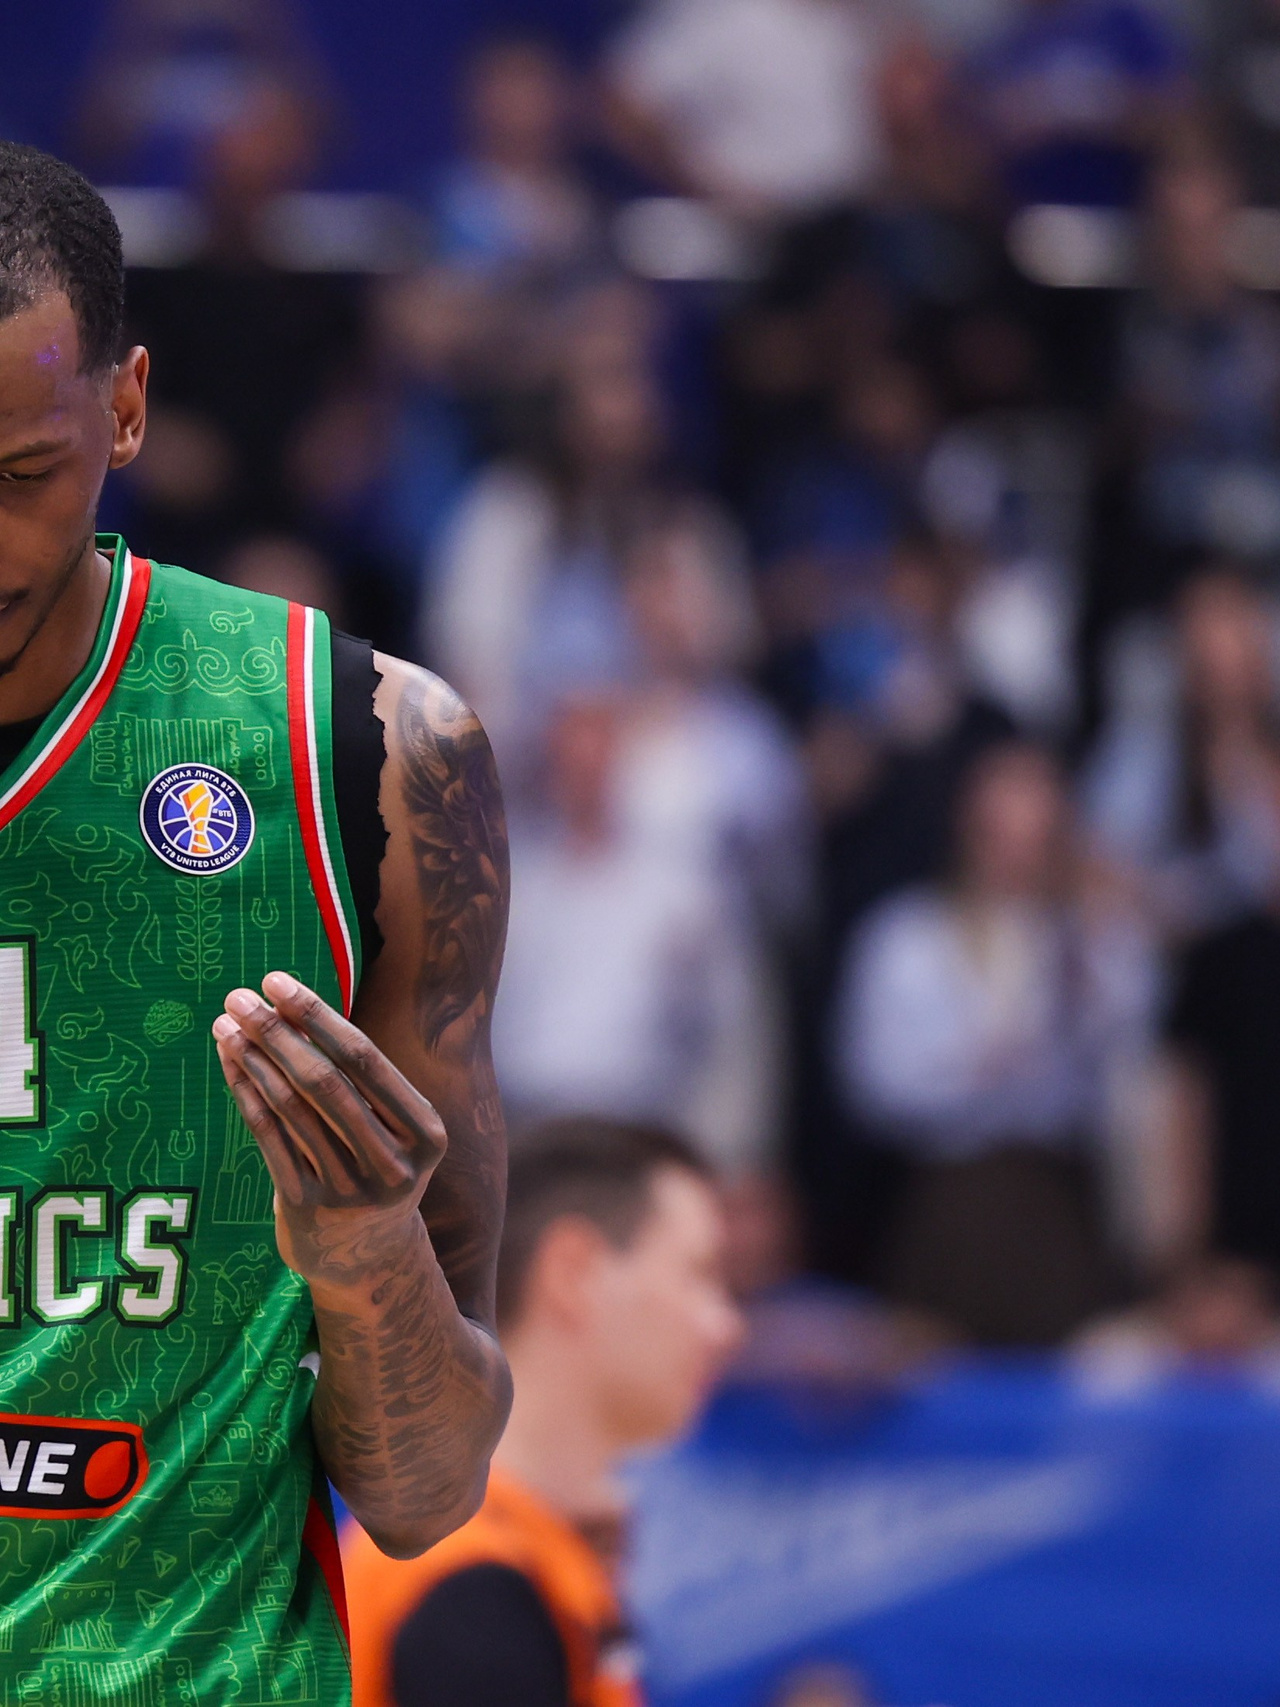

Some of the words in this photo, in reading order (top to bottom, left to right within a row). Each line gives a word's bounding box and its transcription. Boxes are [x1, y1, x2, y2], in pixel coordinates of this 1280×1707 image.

[155, 769, 192, 794] ЕДИНАЯ
[194, 769, 219, 784] ЛИГА
[220, 781, 237, 797] ВТБ
[218, 809, 232, 818] ВТБ
[160, 842, 176, 859] VTB
[176, 855, 210, 868] UNITED
[210, 844, 240, 867] LEAGUE
